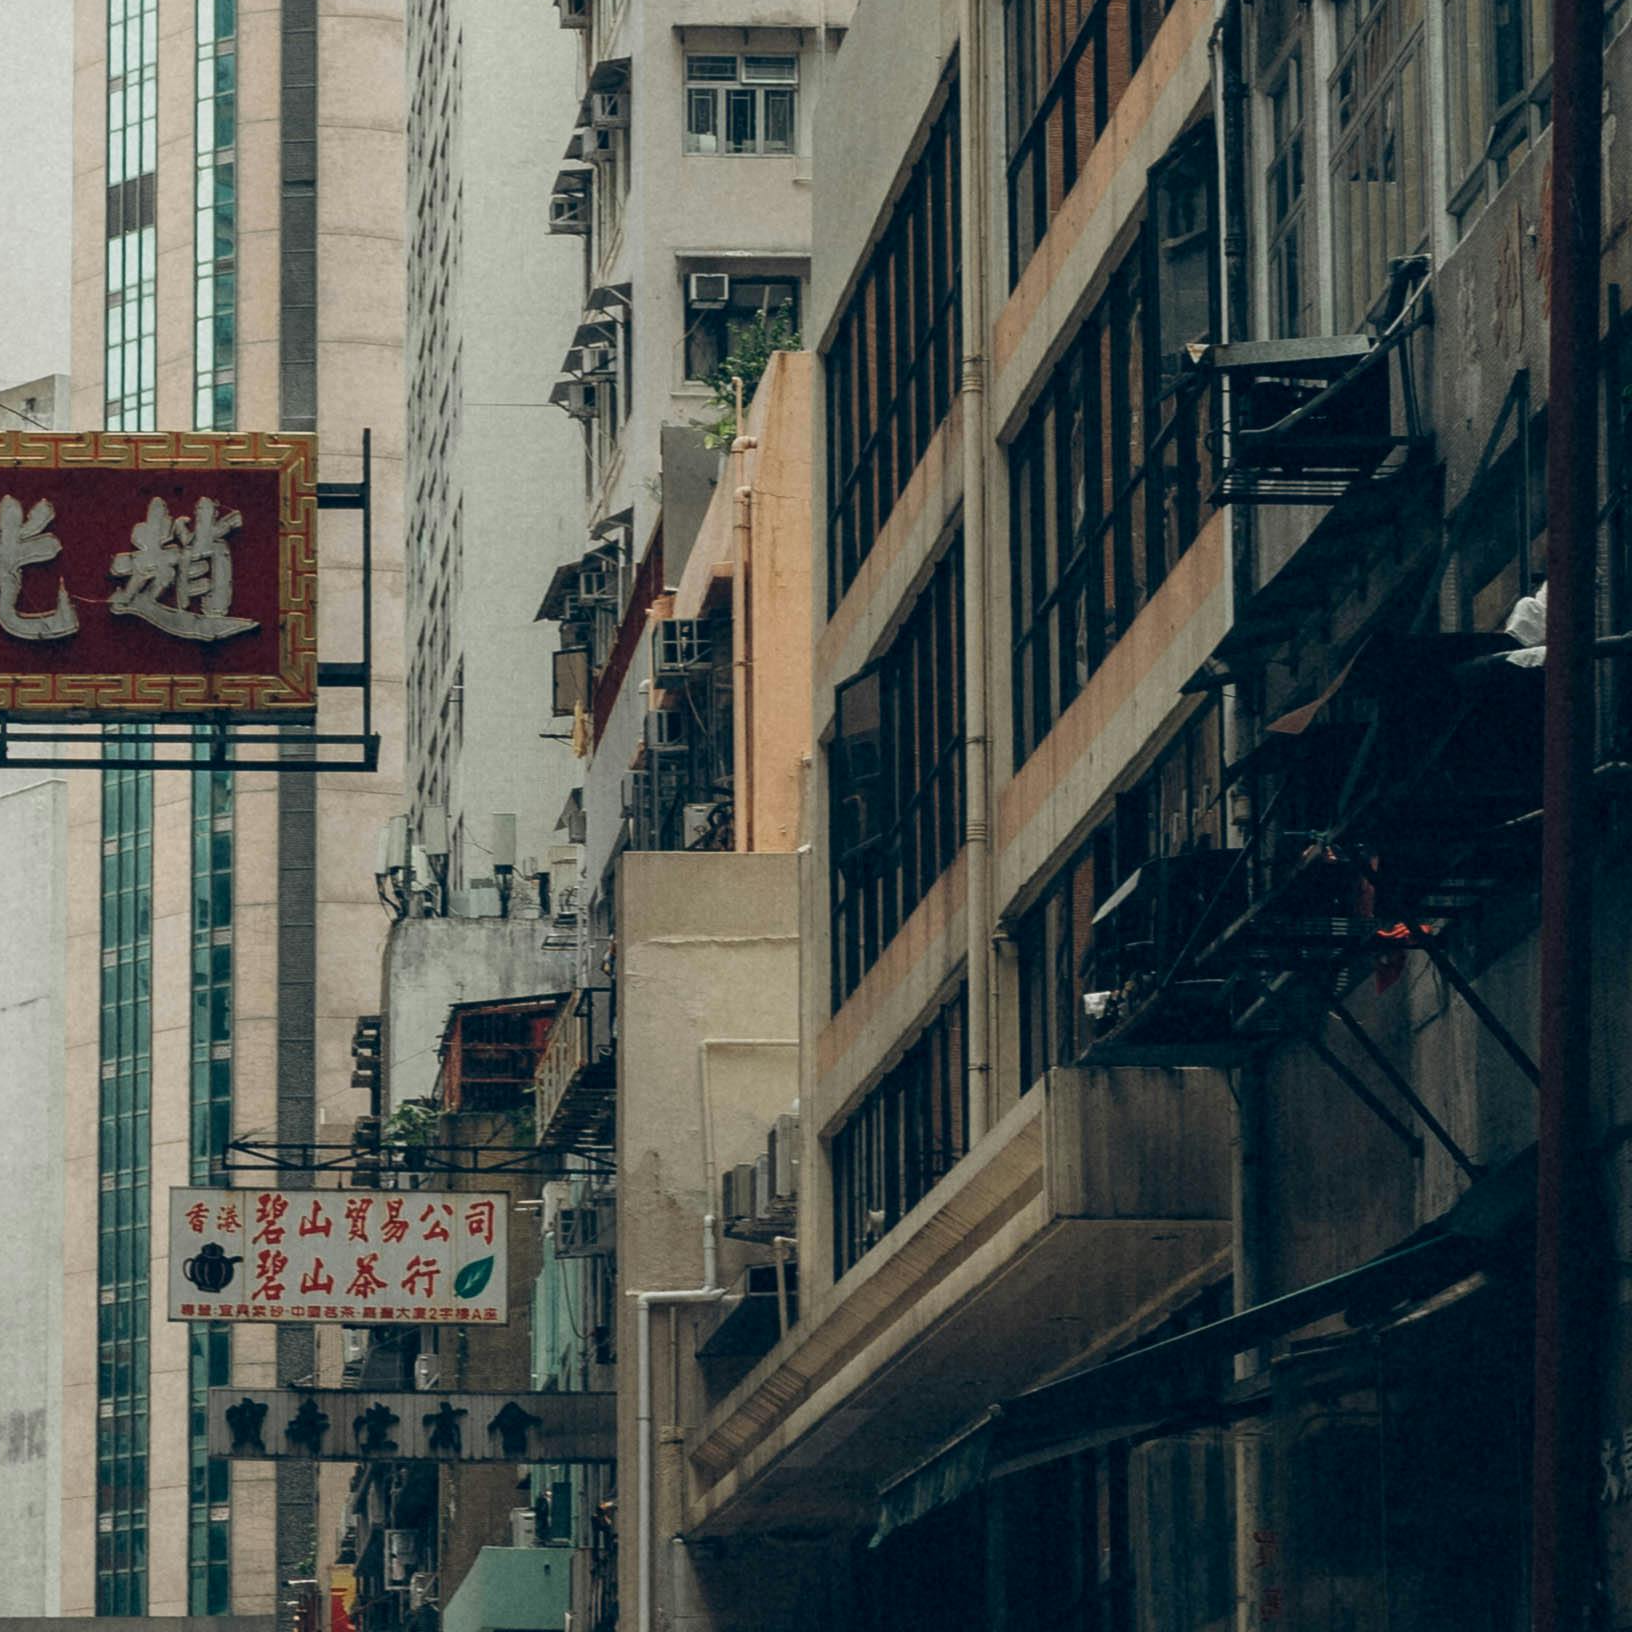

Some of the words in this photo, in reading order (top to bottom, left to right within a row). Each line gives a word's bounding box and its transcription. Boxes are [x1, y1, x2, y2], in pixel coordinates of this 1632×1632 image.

[184, 1202, 243, 1234] 香港
[251, 1193, 496, 1245] 碧山貿易公司
[251, 1249, 442, 1300] 碧山茶行
